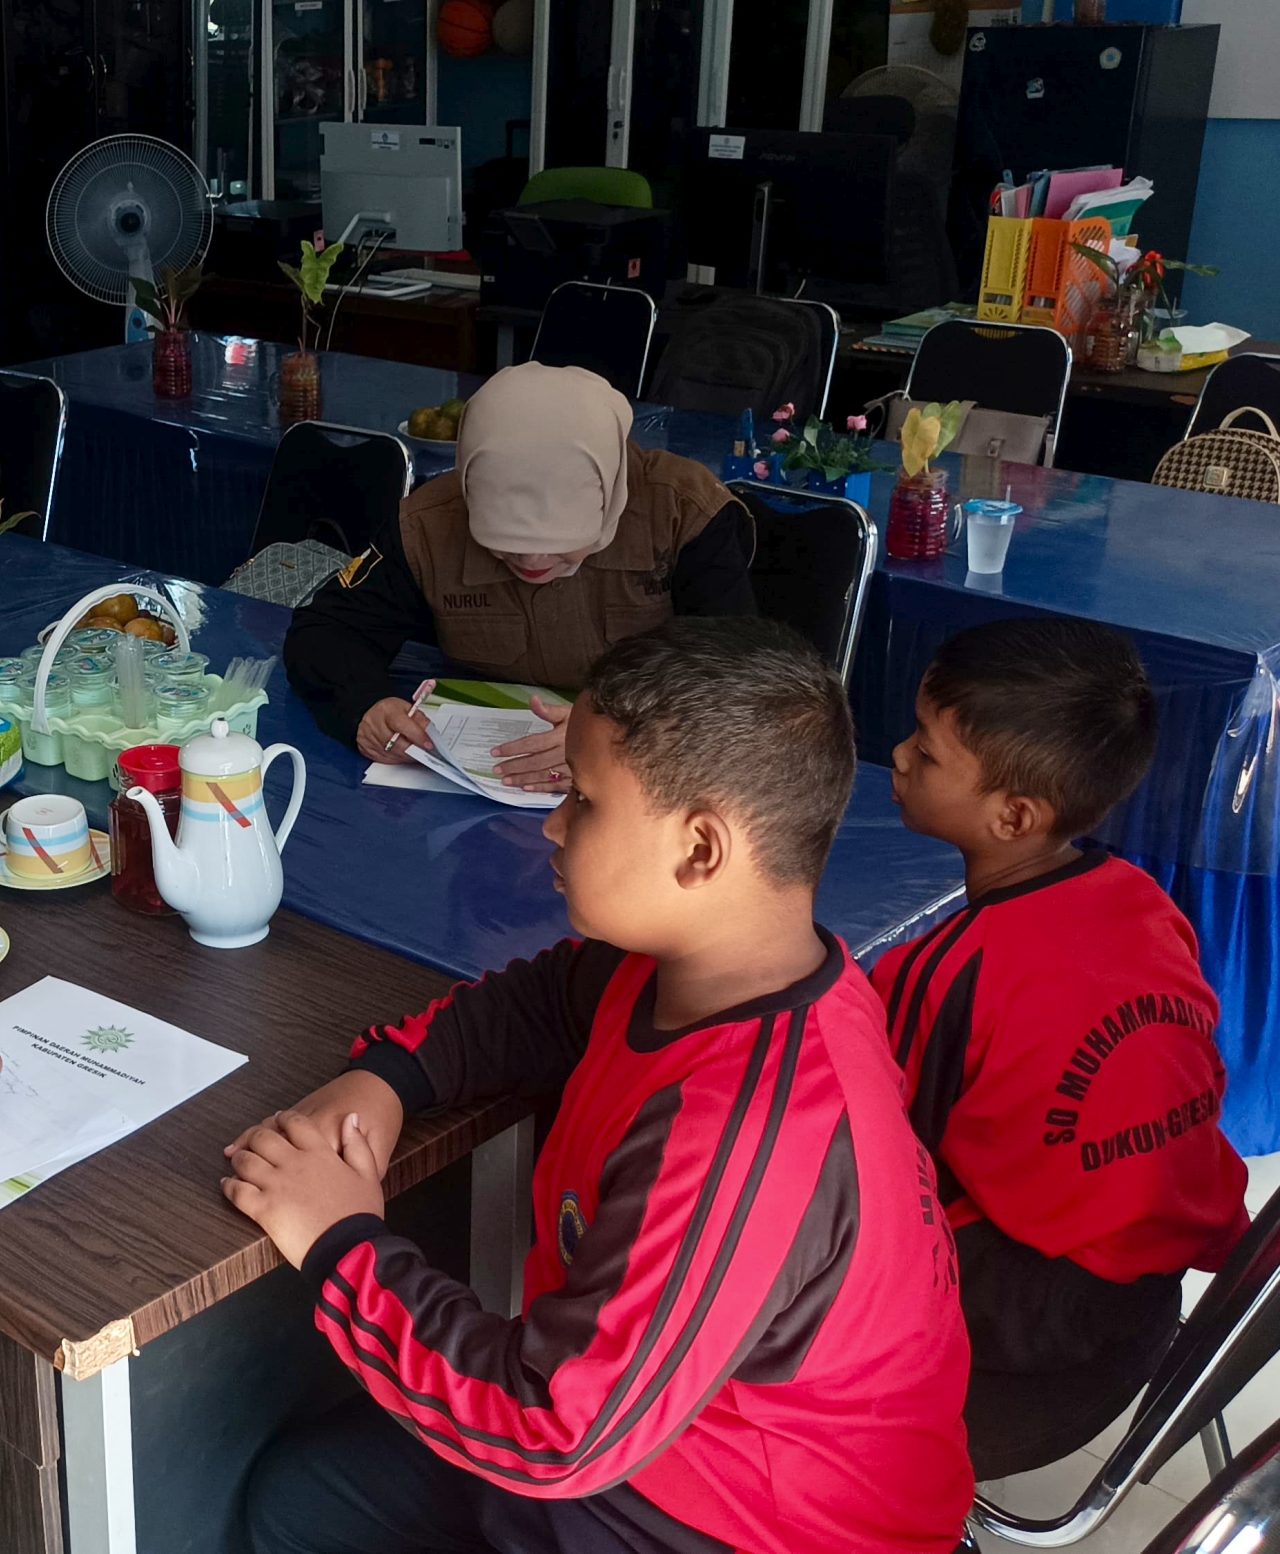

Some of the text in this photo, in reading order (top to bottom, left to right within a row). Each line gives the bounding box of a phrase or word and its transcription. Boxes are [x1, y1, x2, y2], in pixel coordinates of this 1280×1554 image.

[442, 592, 491, 609] NURUL
[12, 1025, 146, 1086] PIMPINAN DAERAH MUHAMMADIYAH
[31, 1043, 107, 1079] KABUPATEN GRESIK
[1043, 1107, 1080, 1146] SD
[1080, 1087, 1218, 1172] DUKUN-GRESI
